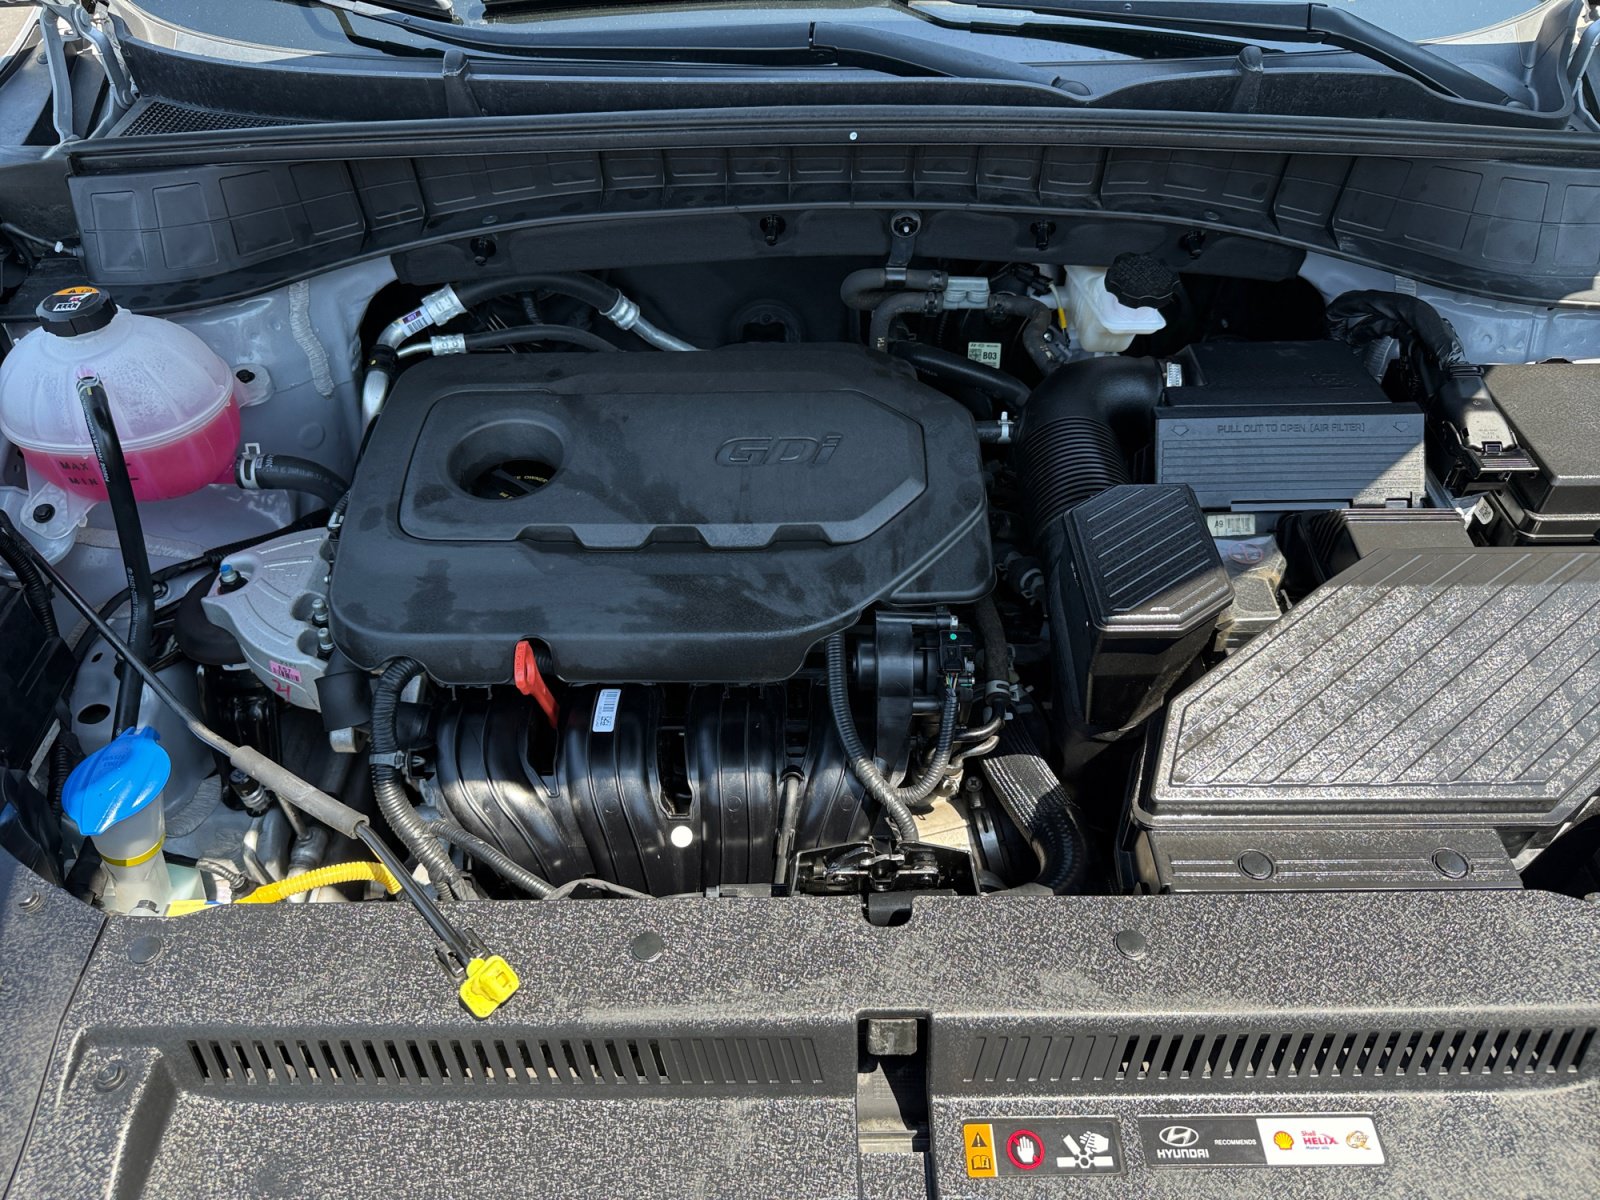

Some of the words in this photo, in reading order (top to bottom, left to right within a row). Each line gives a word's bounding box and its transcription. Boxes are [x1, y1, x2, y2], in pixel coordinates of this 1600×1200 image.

[1216, 424, 1242, 433] PULL
[1243, 424, 1264, 433] OUT
[1265, 423, 1278, 433] TO
[1280, 423, 1306, 433] OPEN
[59, 460, 88, 470] MAX
[68, 477, 98, 486] MIN
[1214, 1138, 1257, 1146] RECOMMENDS
[1303, 1134, 1339, 1145] HELIX
[1156, 1148, 1210, 1159] HYUNDAI
